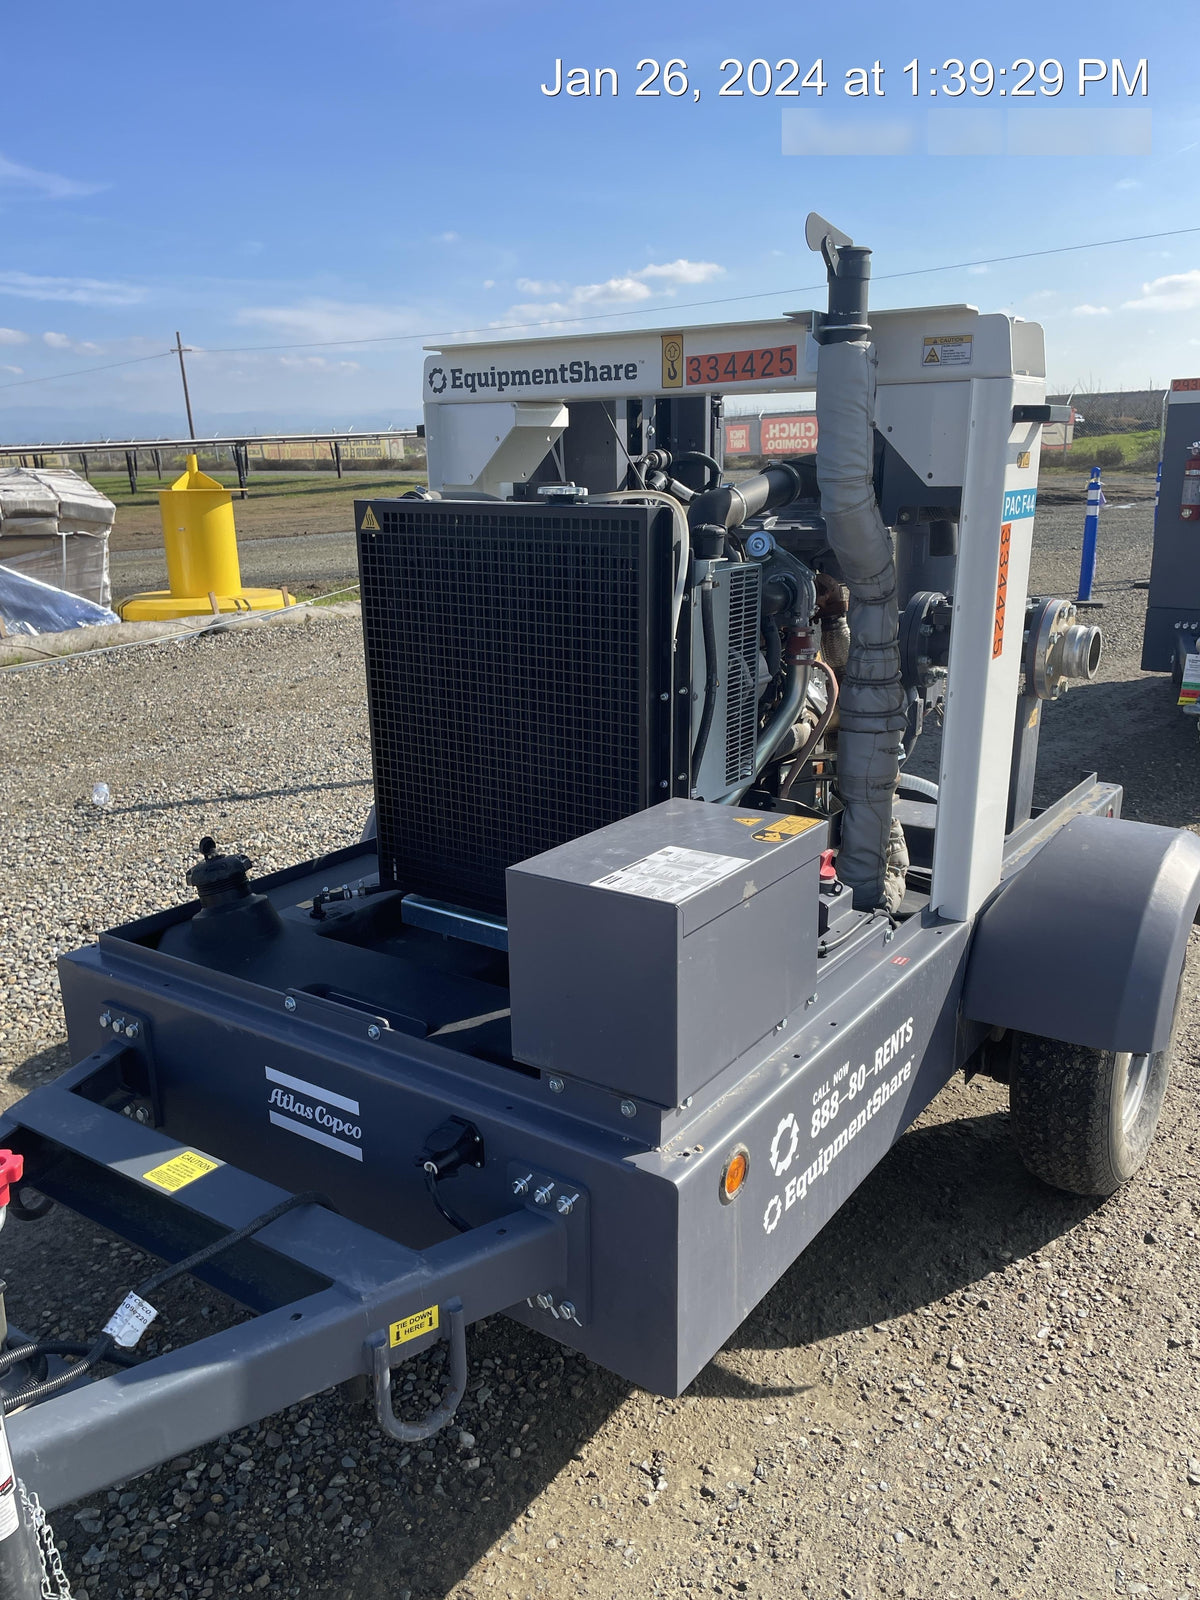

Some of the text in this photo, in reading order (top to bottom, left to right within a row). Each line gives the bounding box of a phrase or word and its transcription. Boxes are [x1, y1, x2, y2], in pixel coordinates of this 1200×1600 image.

[450, 361, 638, 393] EquipmentShare
[689, 348, 793, 383] 334425
[1004, 494, 1035, 516] PAC F44
[993, 528, 1010, 654] 334425
[812, 1061, 849, 1105] CALL NOW
[268, 1088, 362, 1139] Atlas Copco
[785, 1060, 911, 1211] EquipmentShare
[181, 1154, 213, 1171] CAUTION
[396, 1310, 433, 1330] TIE DOWN
[404, 1321, 425, 1335] HERE
